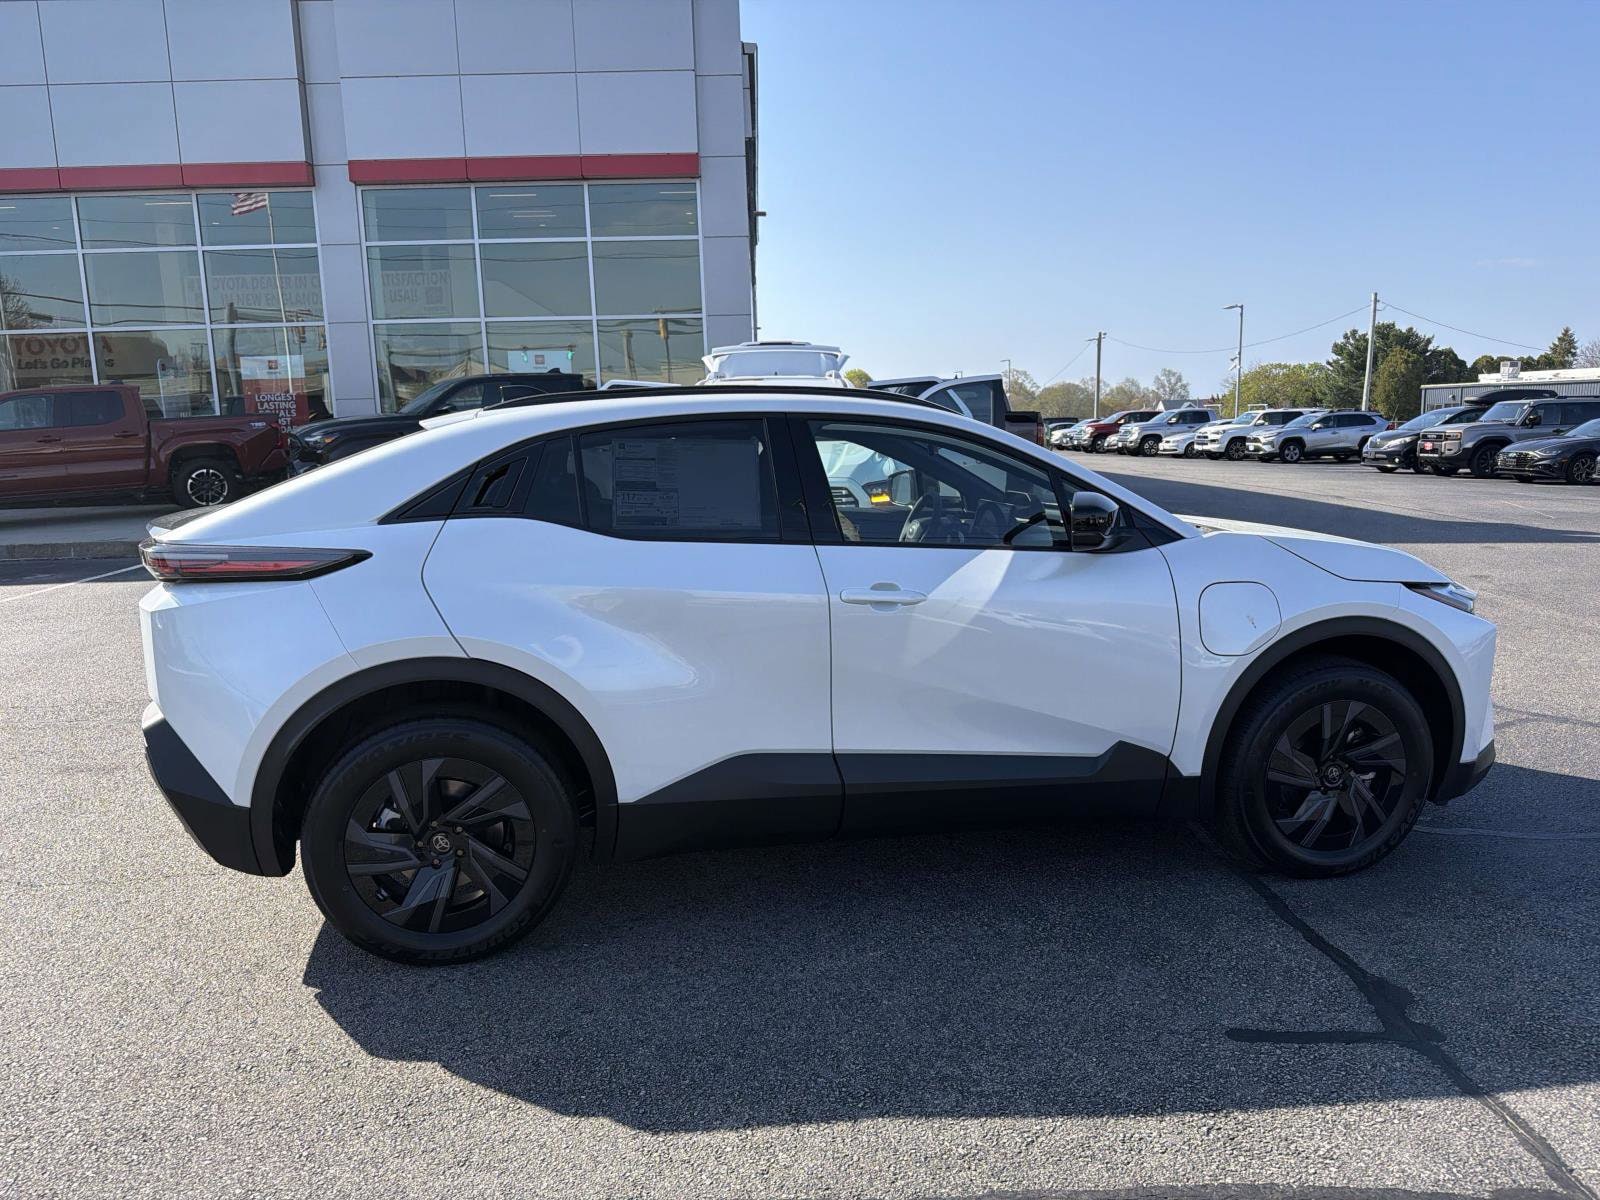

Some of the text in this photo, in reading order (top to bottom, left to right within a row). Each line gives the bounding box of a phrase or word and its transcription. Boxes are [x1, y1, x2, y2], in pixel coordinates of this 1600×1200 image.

[17, 356, 114, 370] Let's Go Plas
[255, 393, 296, 401] LONGEST
[257, 401, 296, 409] LASTING
